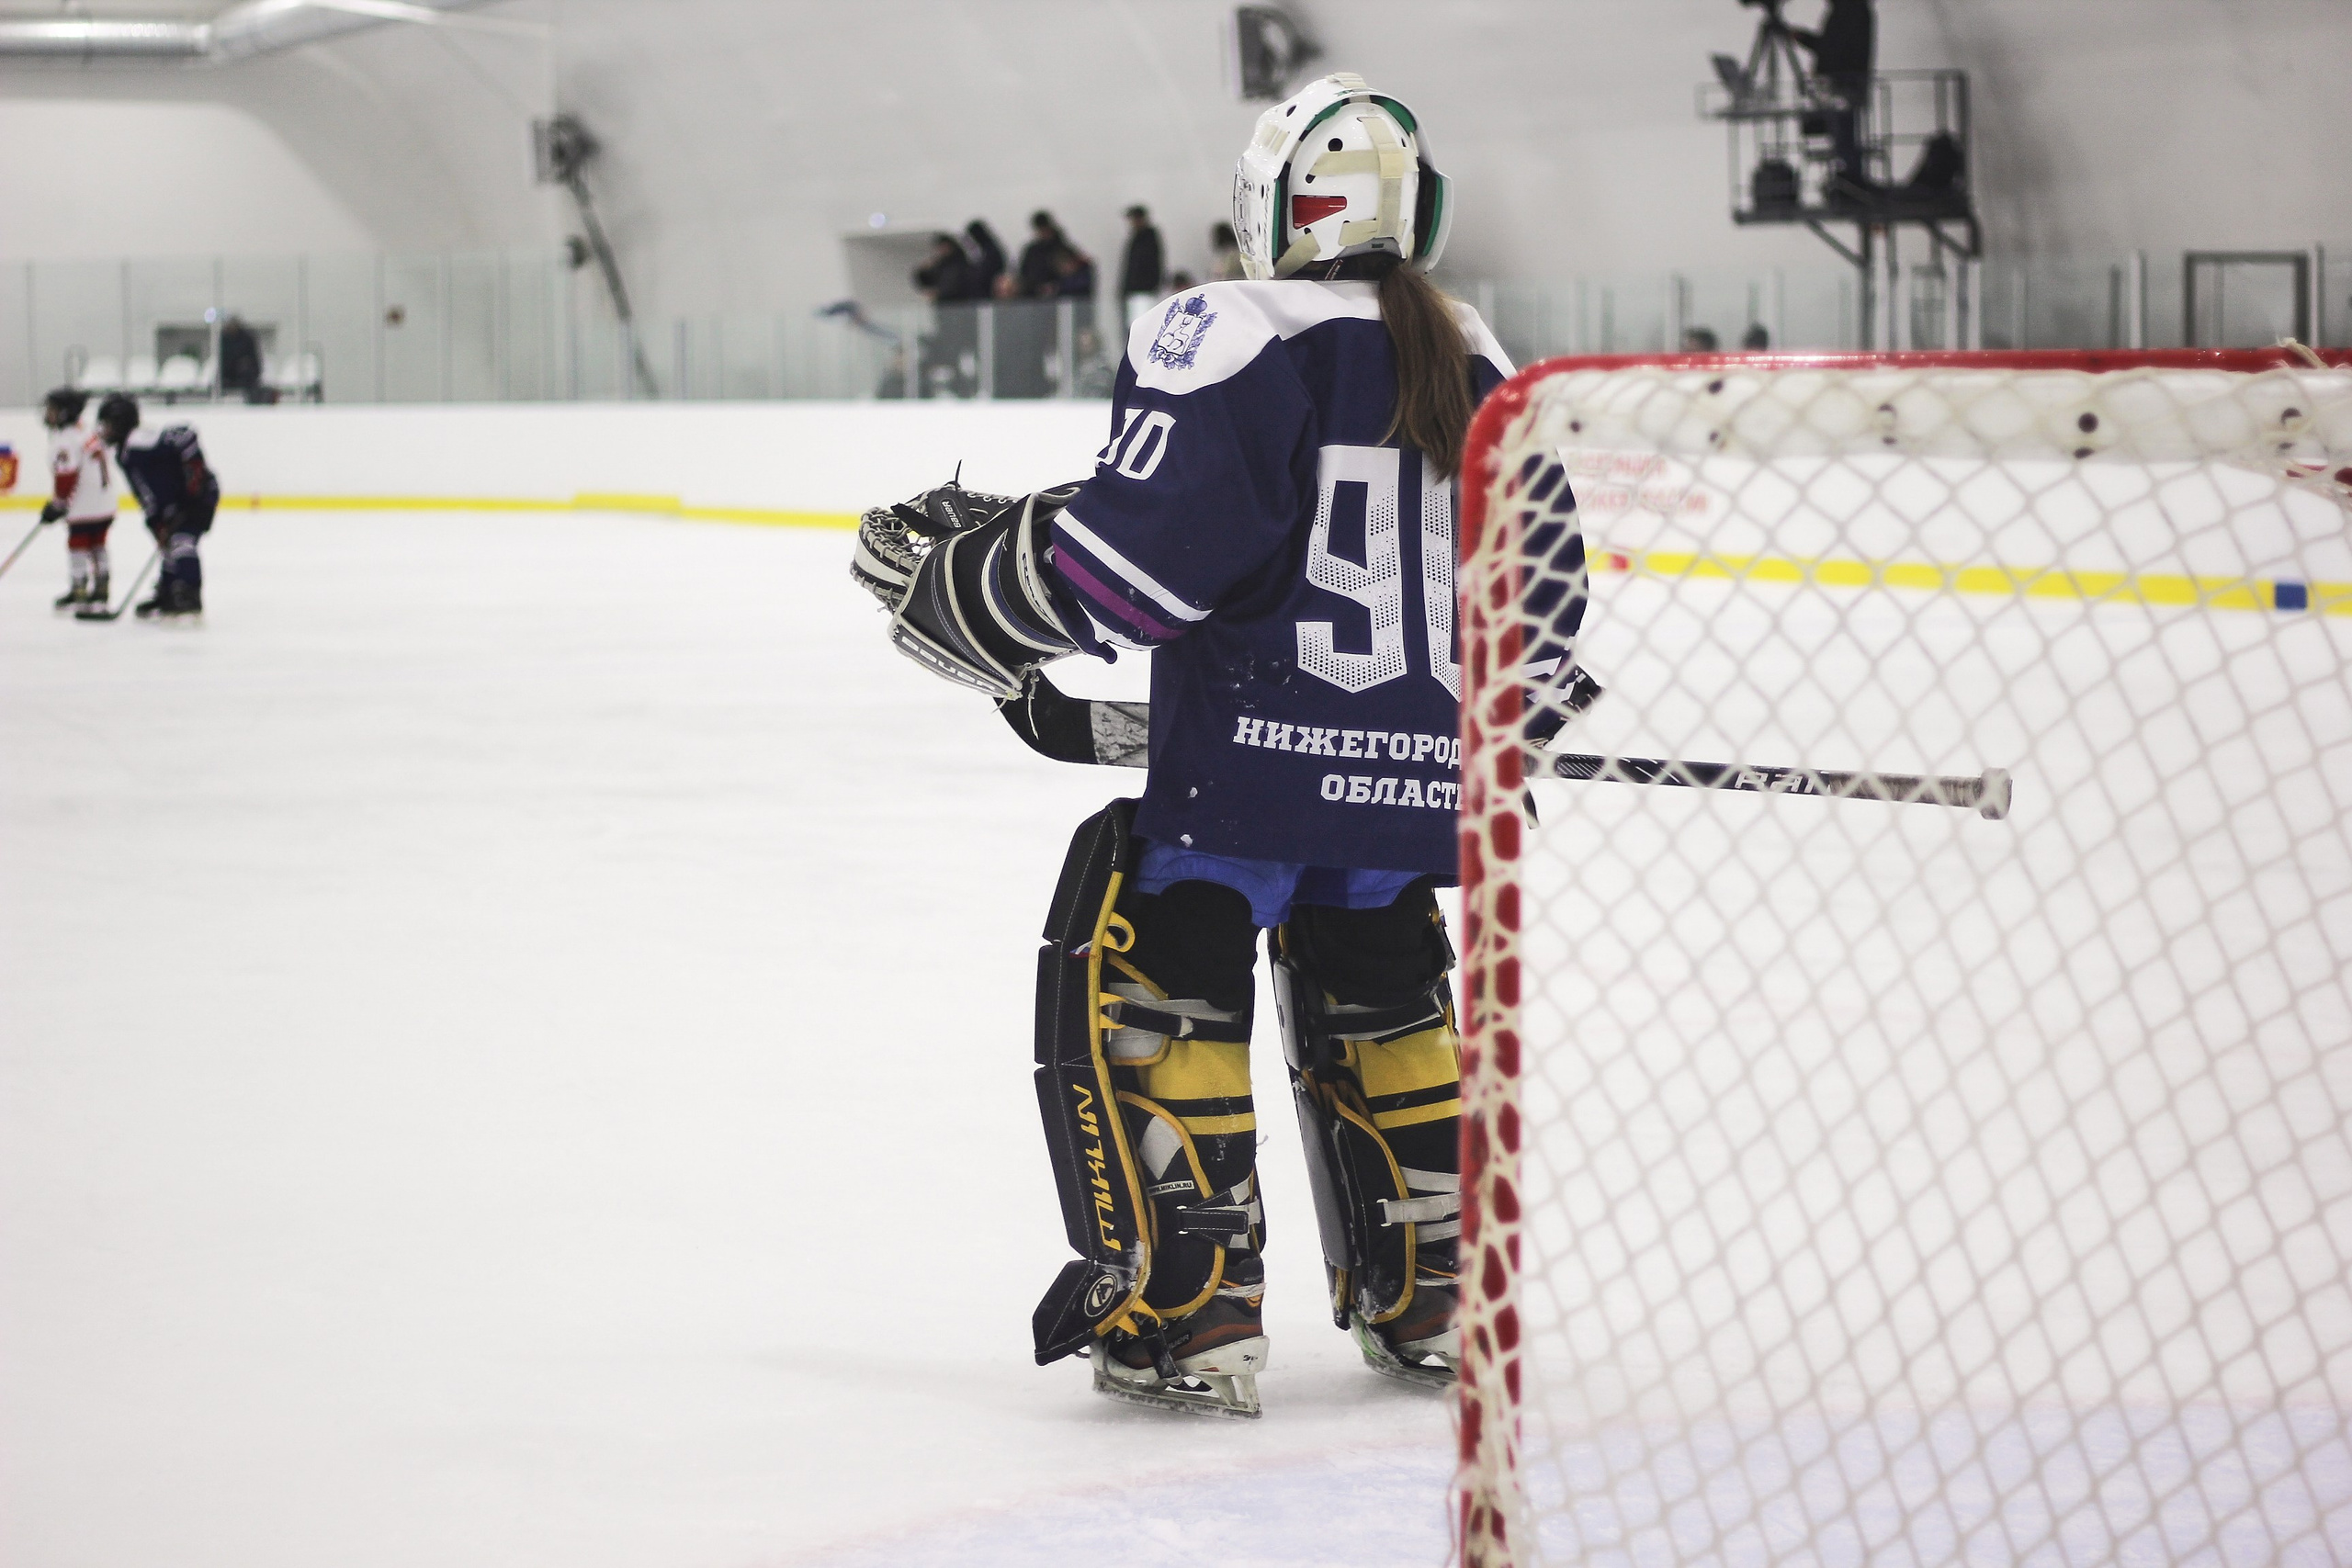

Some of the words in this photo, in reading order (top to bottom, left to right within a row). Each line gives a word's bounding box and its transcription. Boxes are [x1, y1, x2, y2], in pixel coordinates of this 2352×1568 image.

[942, 501, 962, 528] BAUER
[1233, 716, 1462, 770] НИЖЕГОРОД
[1073, 1084, 1121, 1251] MIKLIN
